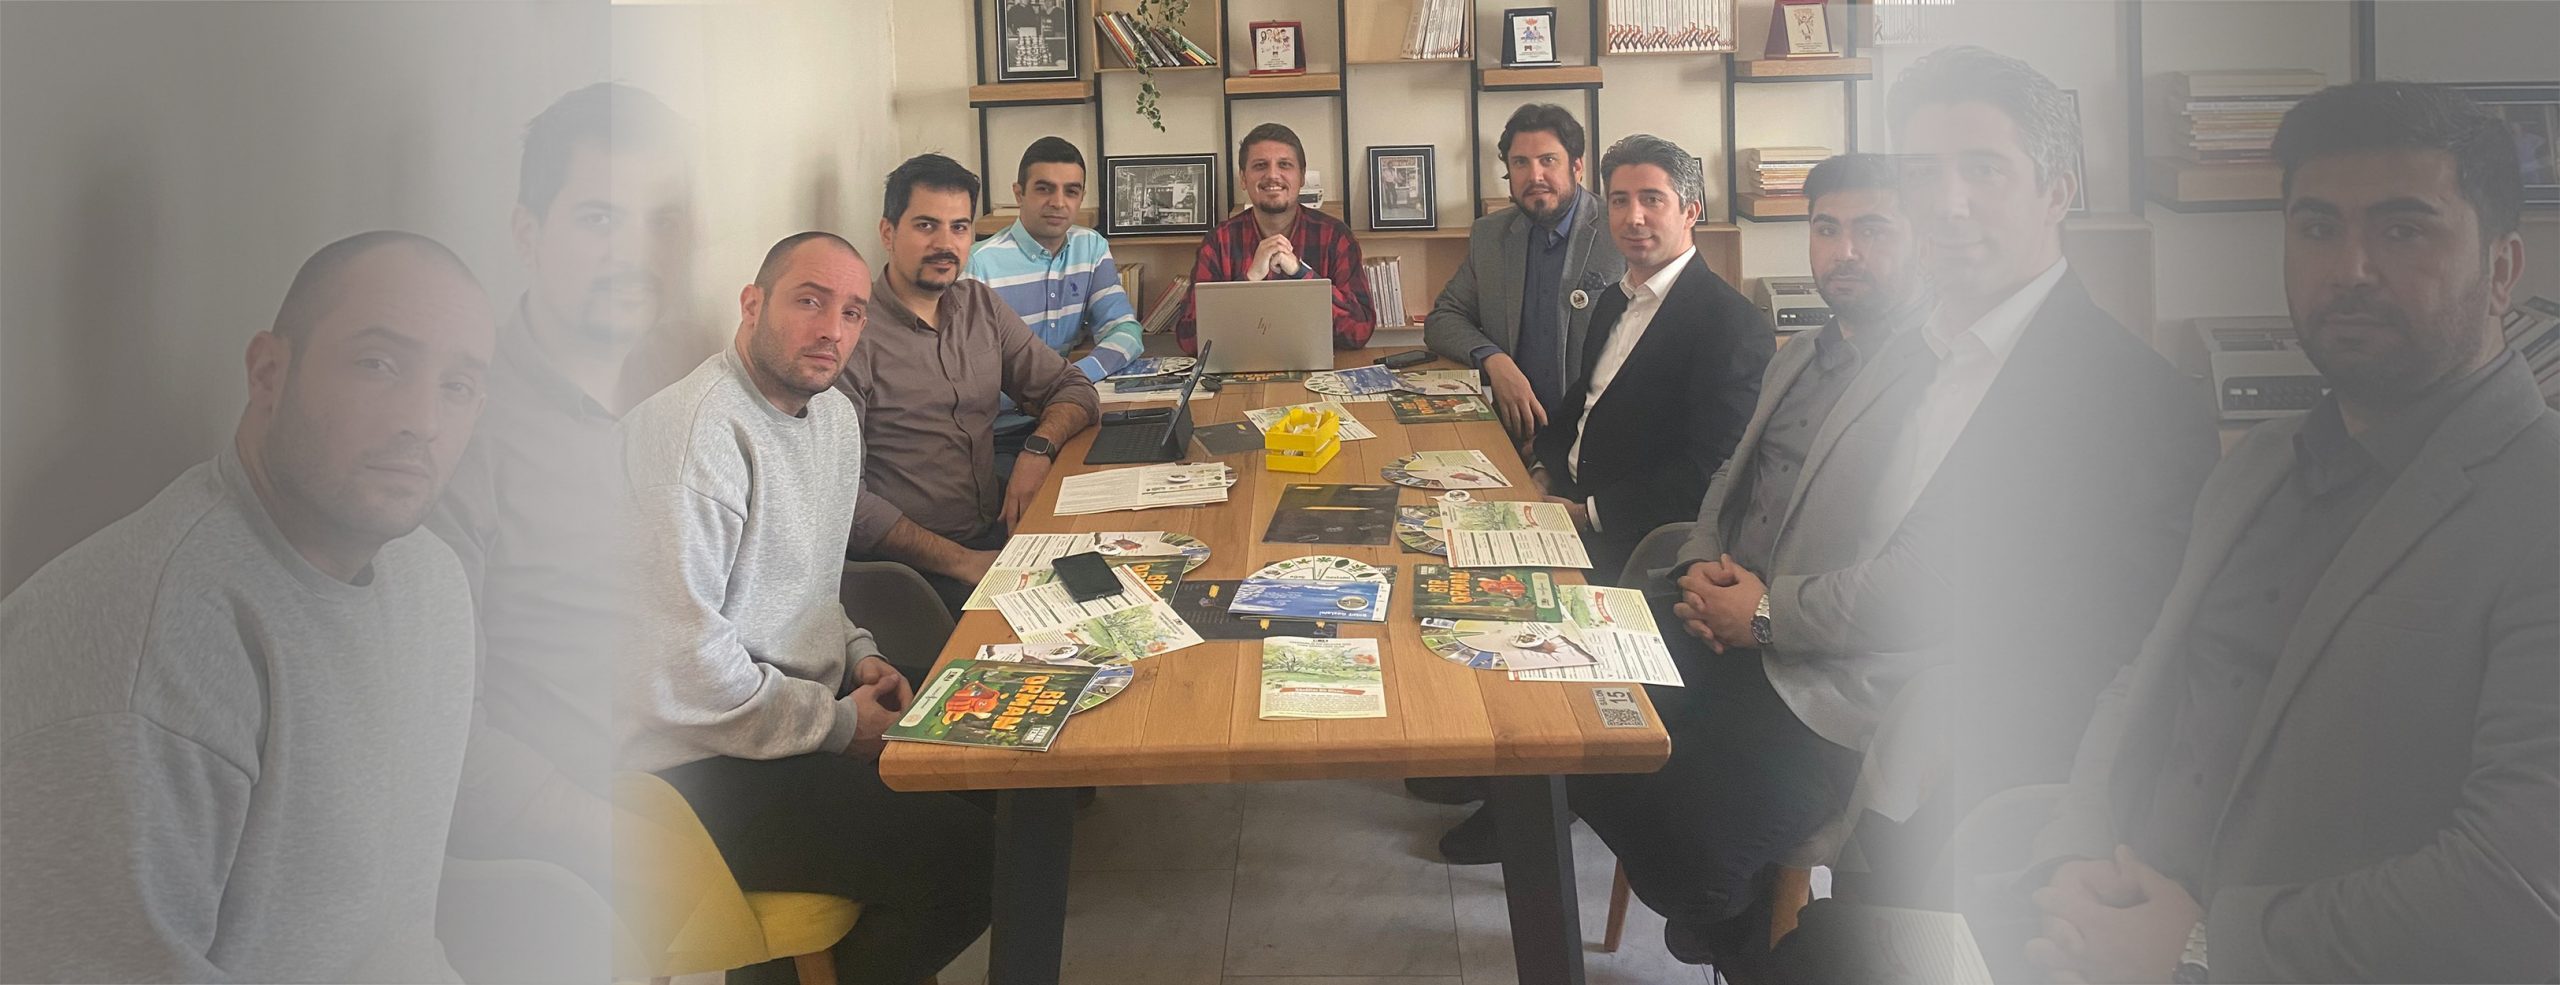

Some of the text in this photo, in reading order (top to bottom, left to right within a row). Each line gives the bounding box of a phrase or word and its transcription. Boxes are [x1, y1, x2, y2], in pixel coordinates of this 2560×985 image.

[991, 675, 1050, 731] ORMAN
[1594, 689, 1608, 706] SALON
[1606, 691, 1628, 704] 15
